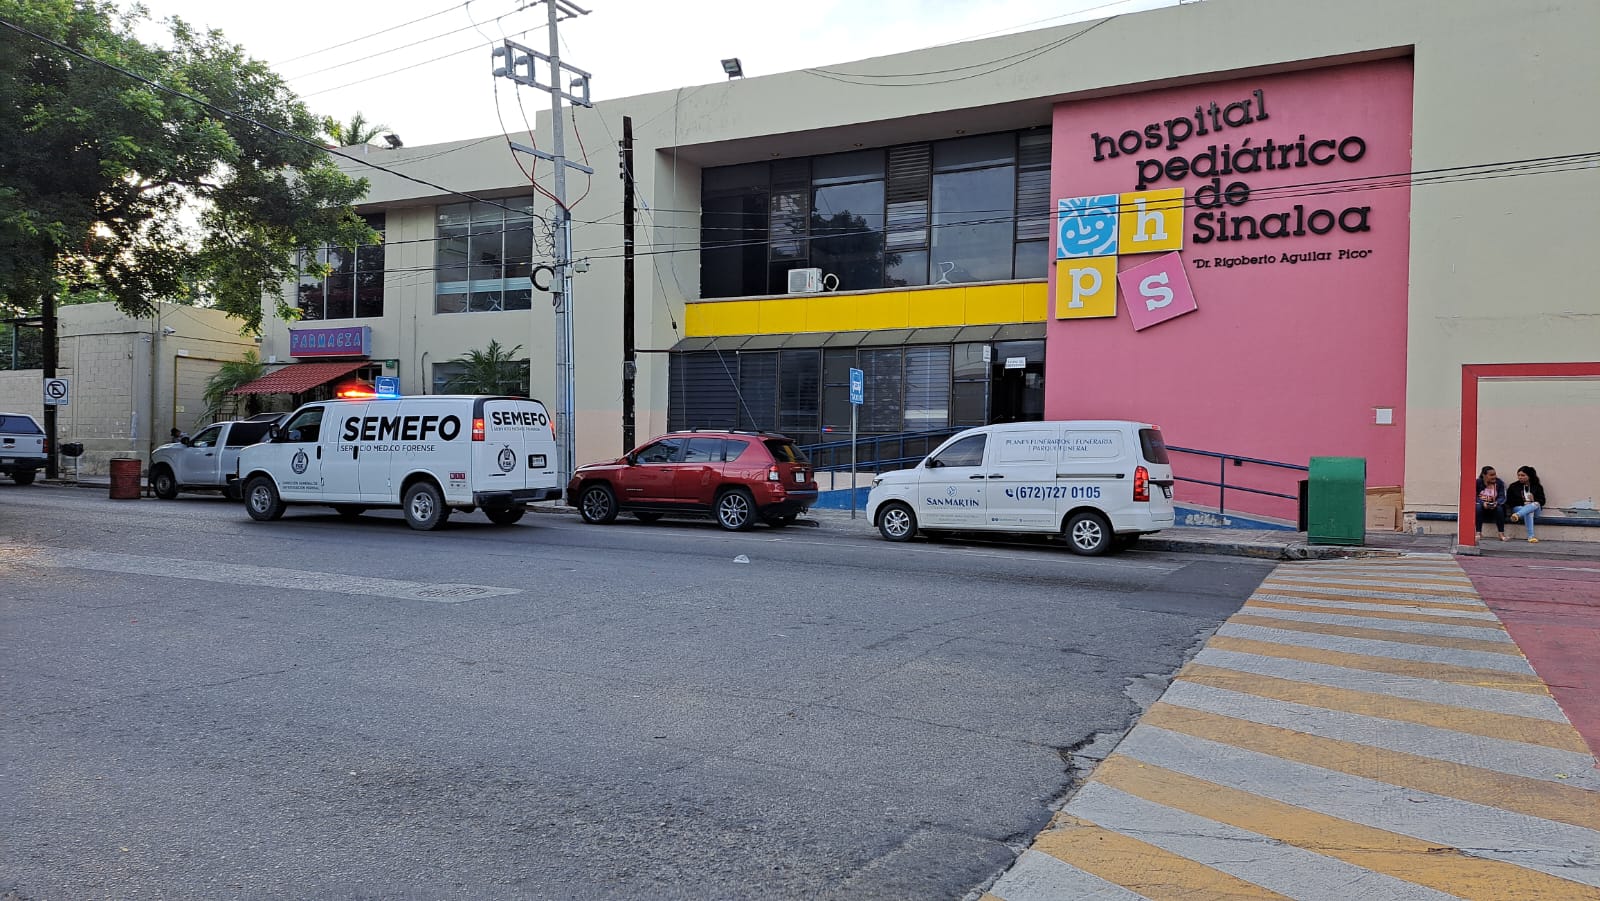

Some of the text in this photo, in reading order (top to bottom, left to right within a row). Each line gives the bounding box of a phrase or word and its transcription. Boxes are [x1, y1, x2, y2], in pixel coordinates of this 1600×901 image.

[1091, 89, 1269, 162] hospital
[1135, 134, 1367, 190] pediátrico
[1194, 178, 1251, 210] de
[1132, 197, 1168, 242] h
[1193, 204, 1371, 243] Sinaloa
[1214, 254, 1276, 268] Rigoberto
[1280, 251, 1332, 264] Aguilar
[1068, 267, 1102, 308] p
[1139, 271, 1174, 311] s
[292, 332, 361, 348] FARMACIA
[342, 415, 461, 442] SEMEFO
[491, 411, 547, 426] SEMEFO
[402, 444, 435, 452] FORENSE
[1015, 486, 1101, 501] (672)727 0105
